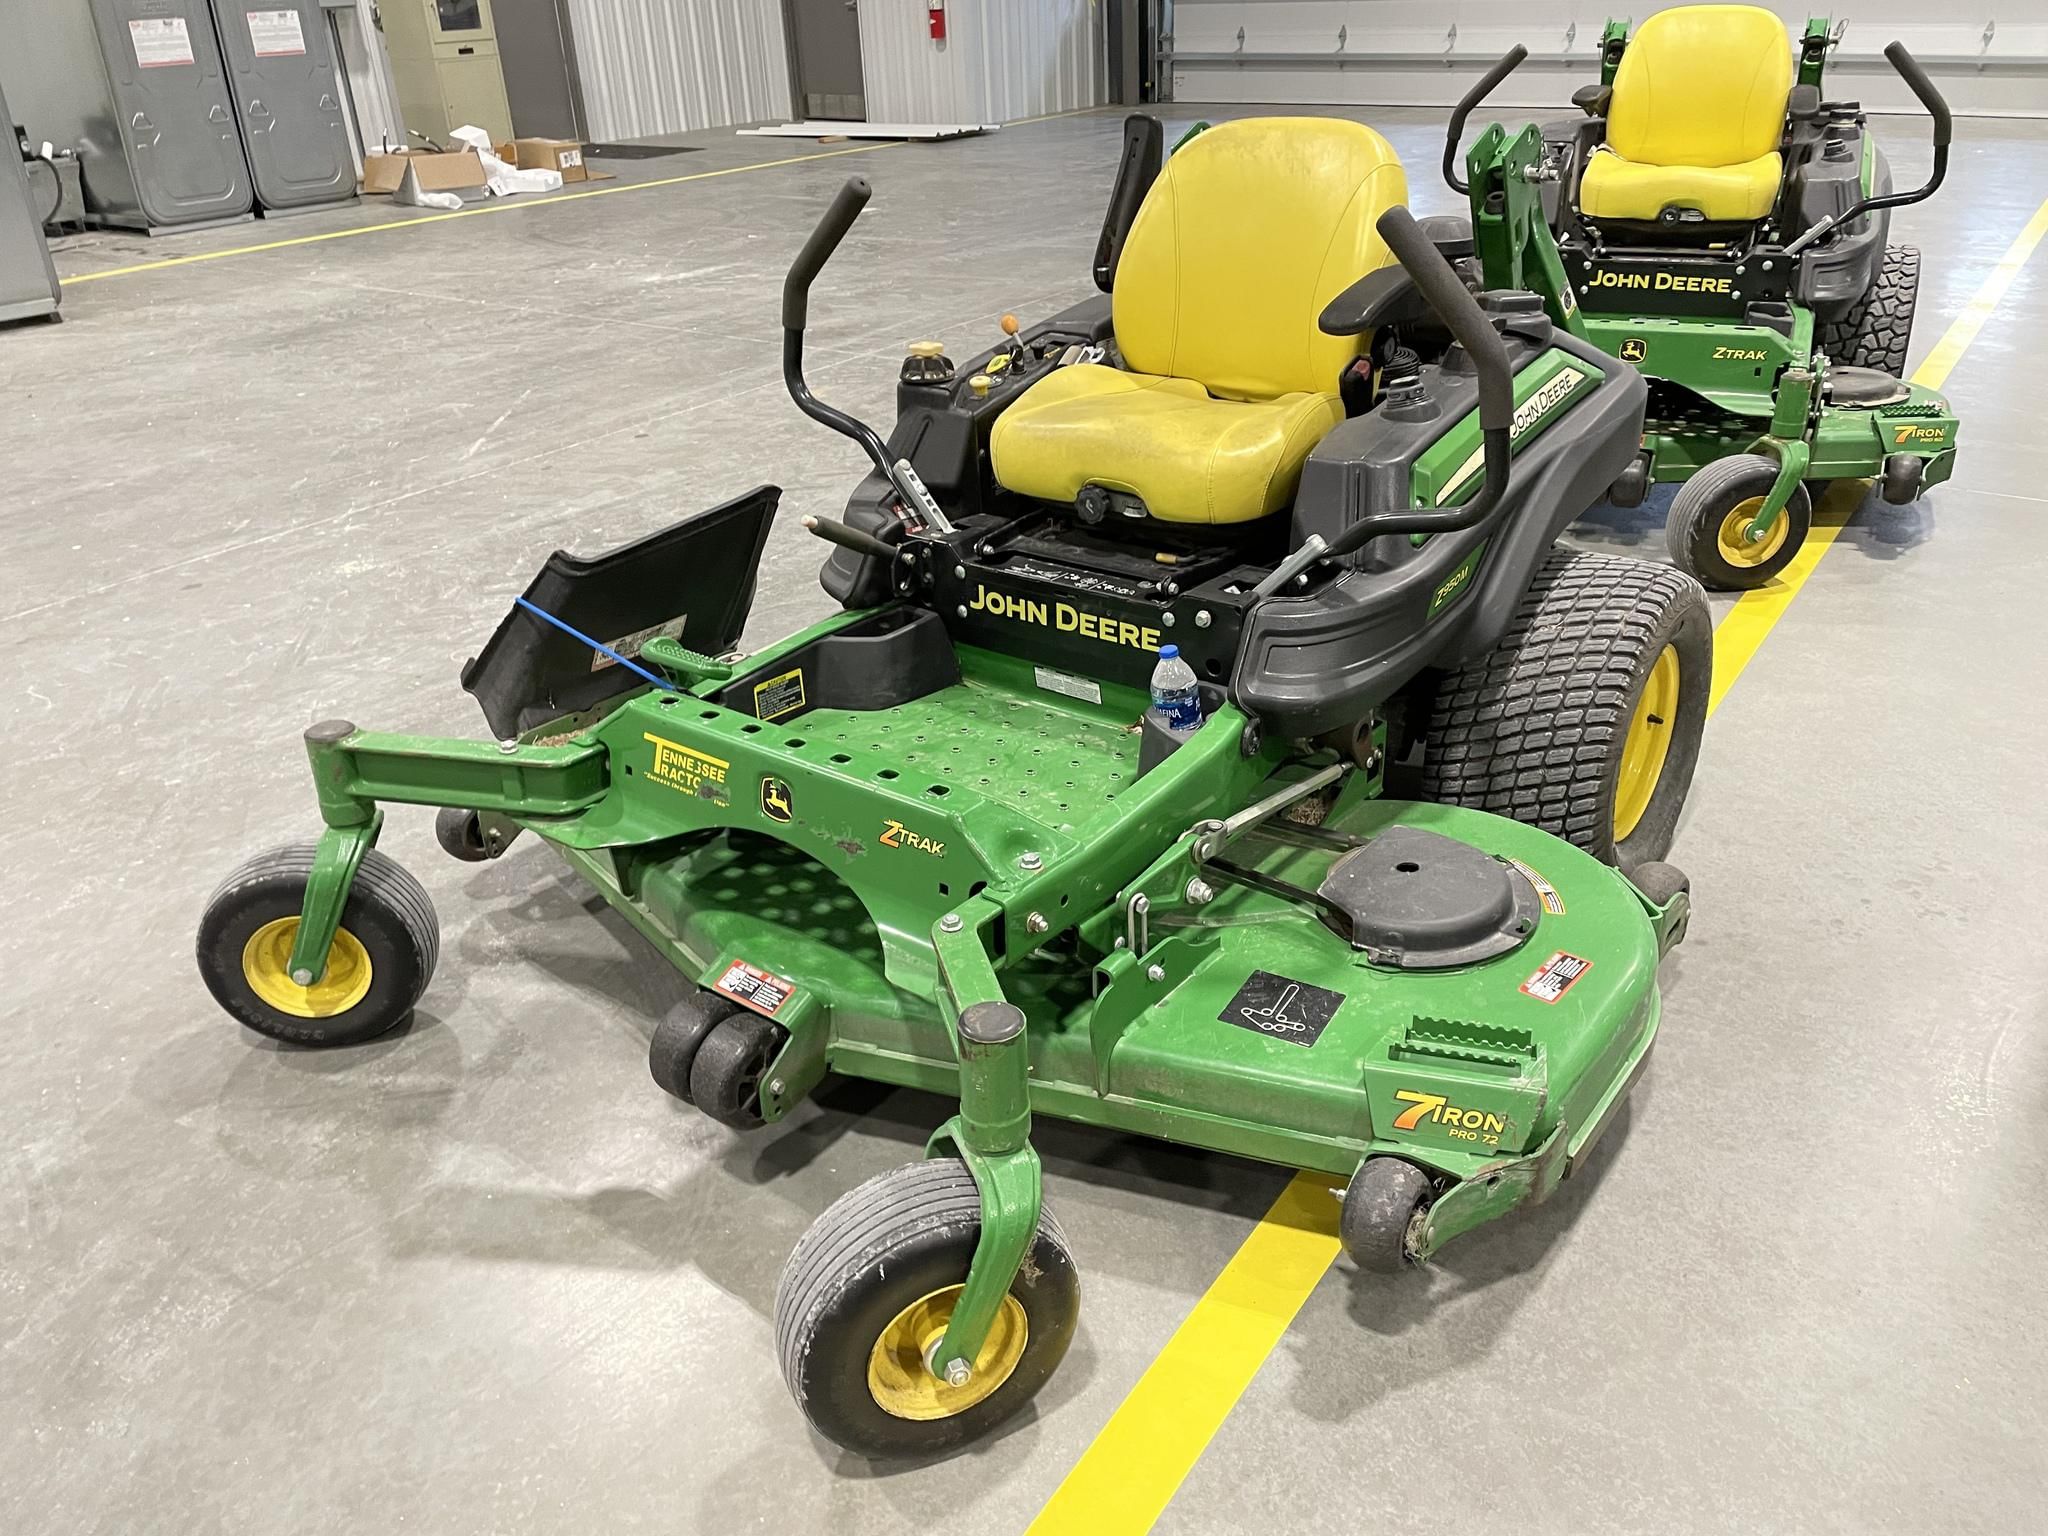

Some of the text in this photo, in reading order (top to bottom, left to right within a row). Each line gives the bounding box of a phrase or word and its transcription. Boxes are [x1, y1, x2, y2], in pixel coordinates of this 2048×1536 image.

[1589, 270, 1732, 293] JOHN DEERE
[1712, 346, 1768, 360] ZTRAK
[1513, 373, 1573, 436] JOHN DEERE
[970, 584, 1161, 652] JOHN DEERE
[880, 819, 945, 858] ZTRAK
[1448, 1128, 1499, 1145] PRO 72
